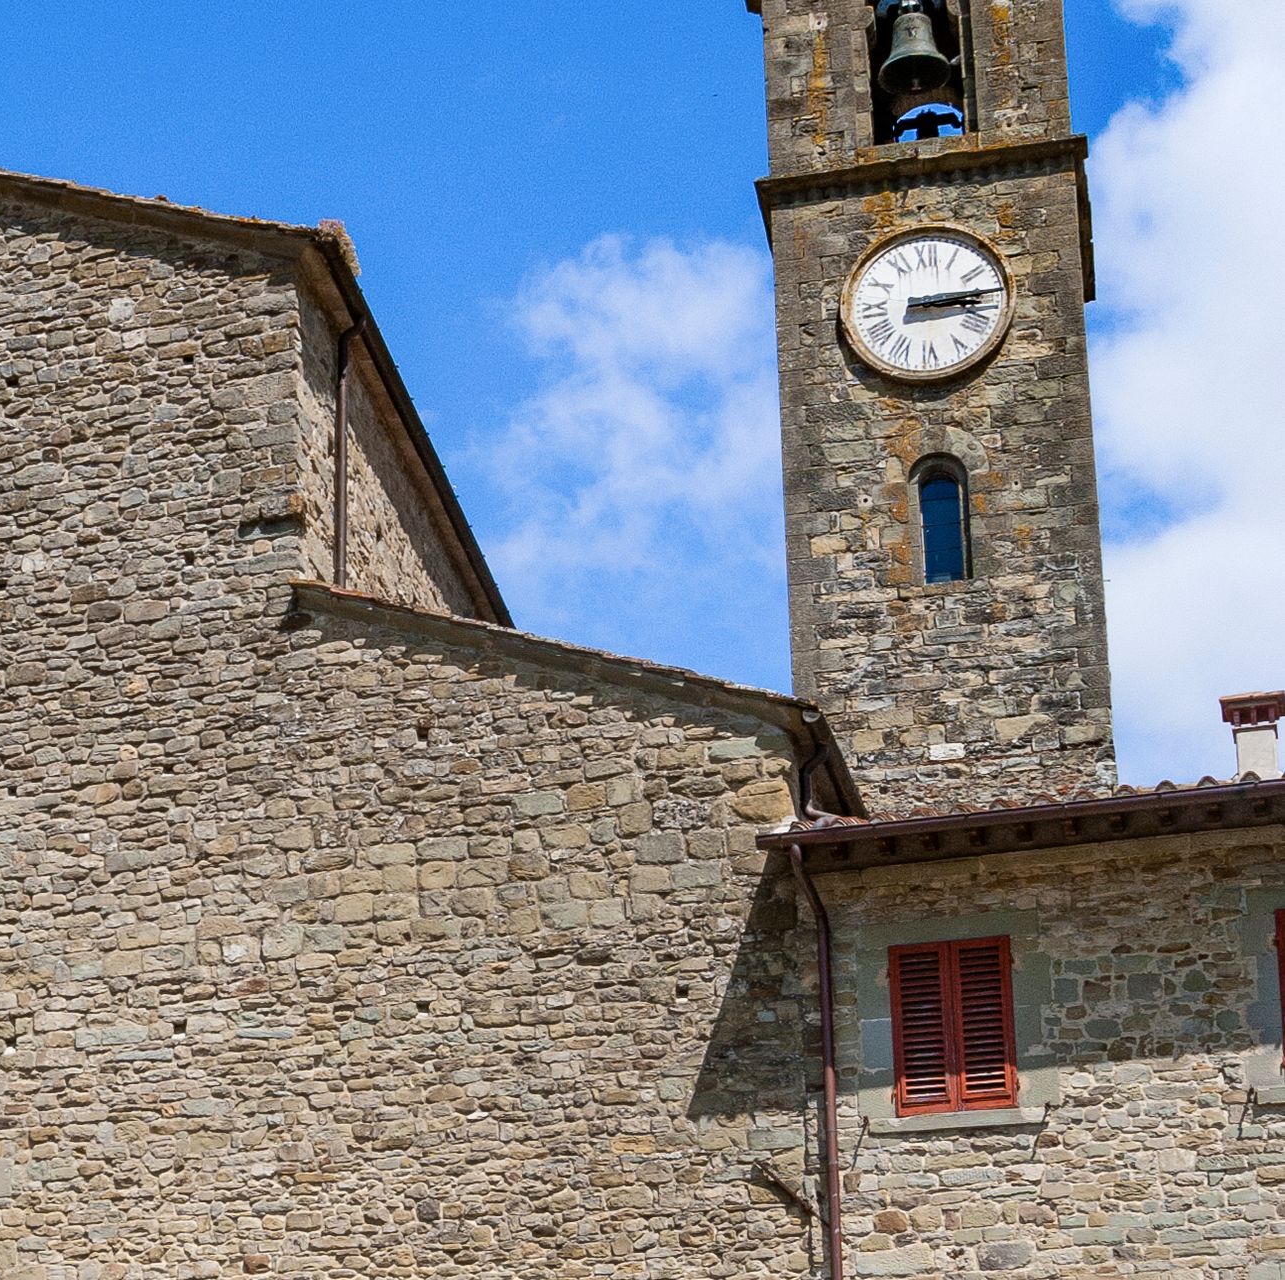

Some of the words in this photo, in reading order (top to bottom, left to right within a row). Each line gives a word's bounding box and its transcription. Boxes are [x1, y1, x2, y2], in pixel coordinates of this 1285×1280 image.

[886, 252, 913, 277] XI
[914, 244, 937, 271] XII
[945, 248, 959, 270] I
[960, 264, 985, 282] II
[868, 277, 895, 294] X
[862, 300, 888, 319] IX
[866, 317, 897, 346] VIII
[888, 333, 911, 361] VII
[922, 339, 939, 364] VI
[950, 333, 968, 357] V
